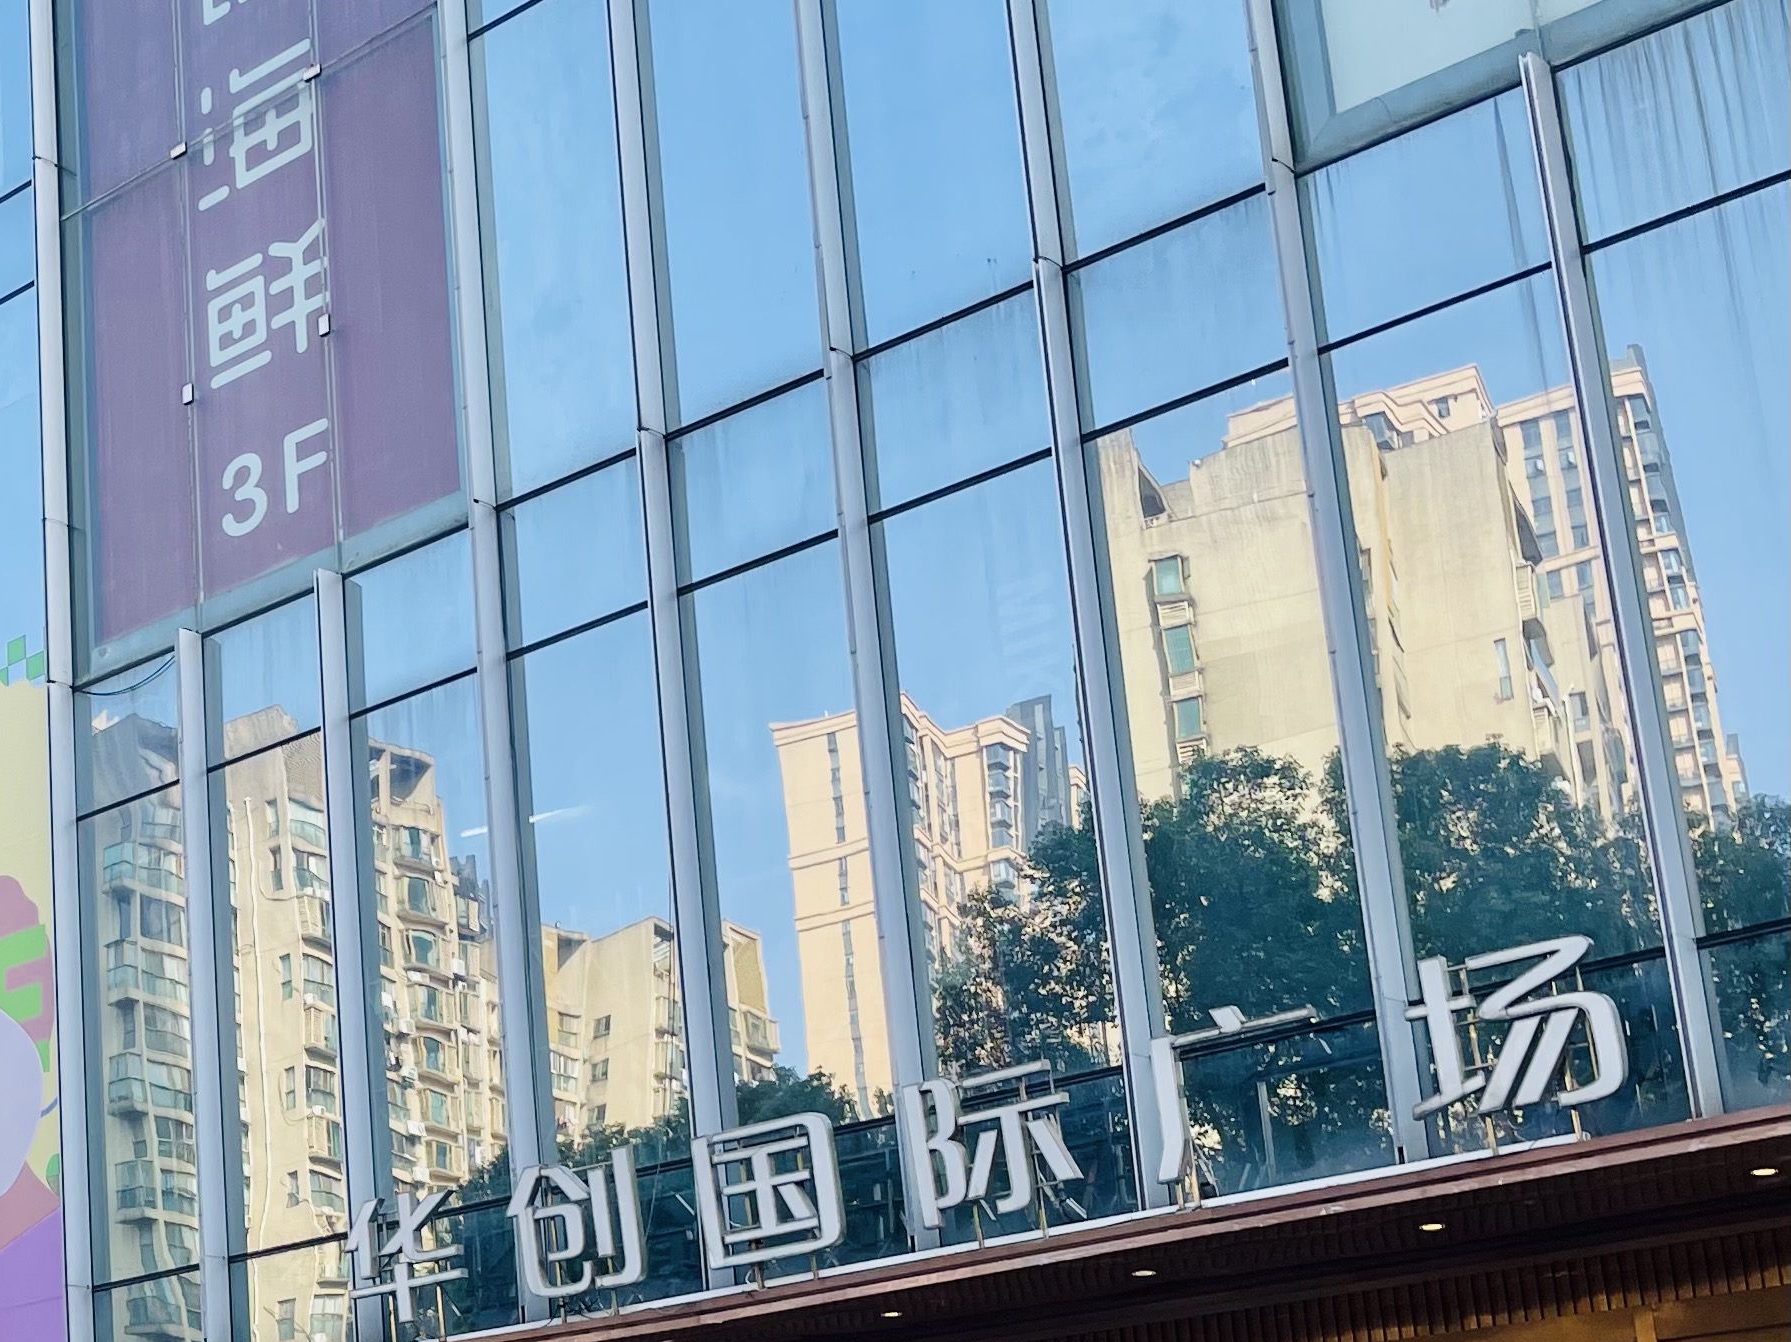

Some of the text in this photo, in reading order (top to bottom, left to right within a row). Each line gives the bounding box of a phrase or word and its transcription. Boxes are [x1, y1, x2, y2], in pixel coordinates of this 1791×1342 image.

[222, 418, 329, 537] 3F
[347, 935, 1629, 1322] 华创国际广场
